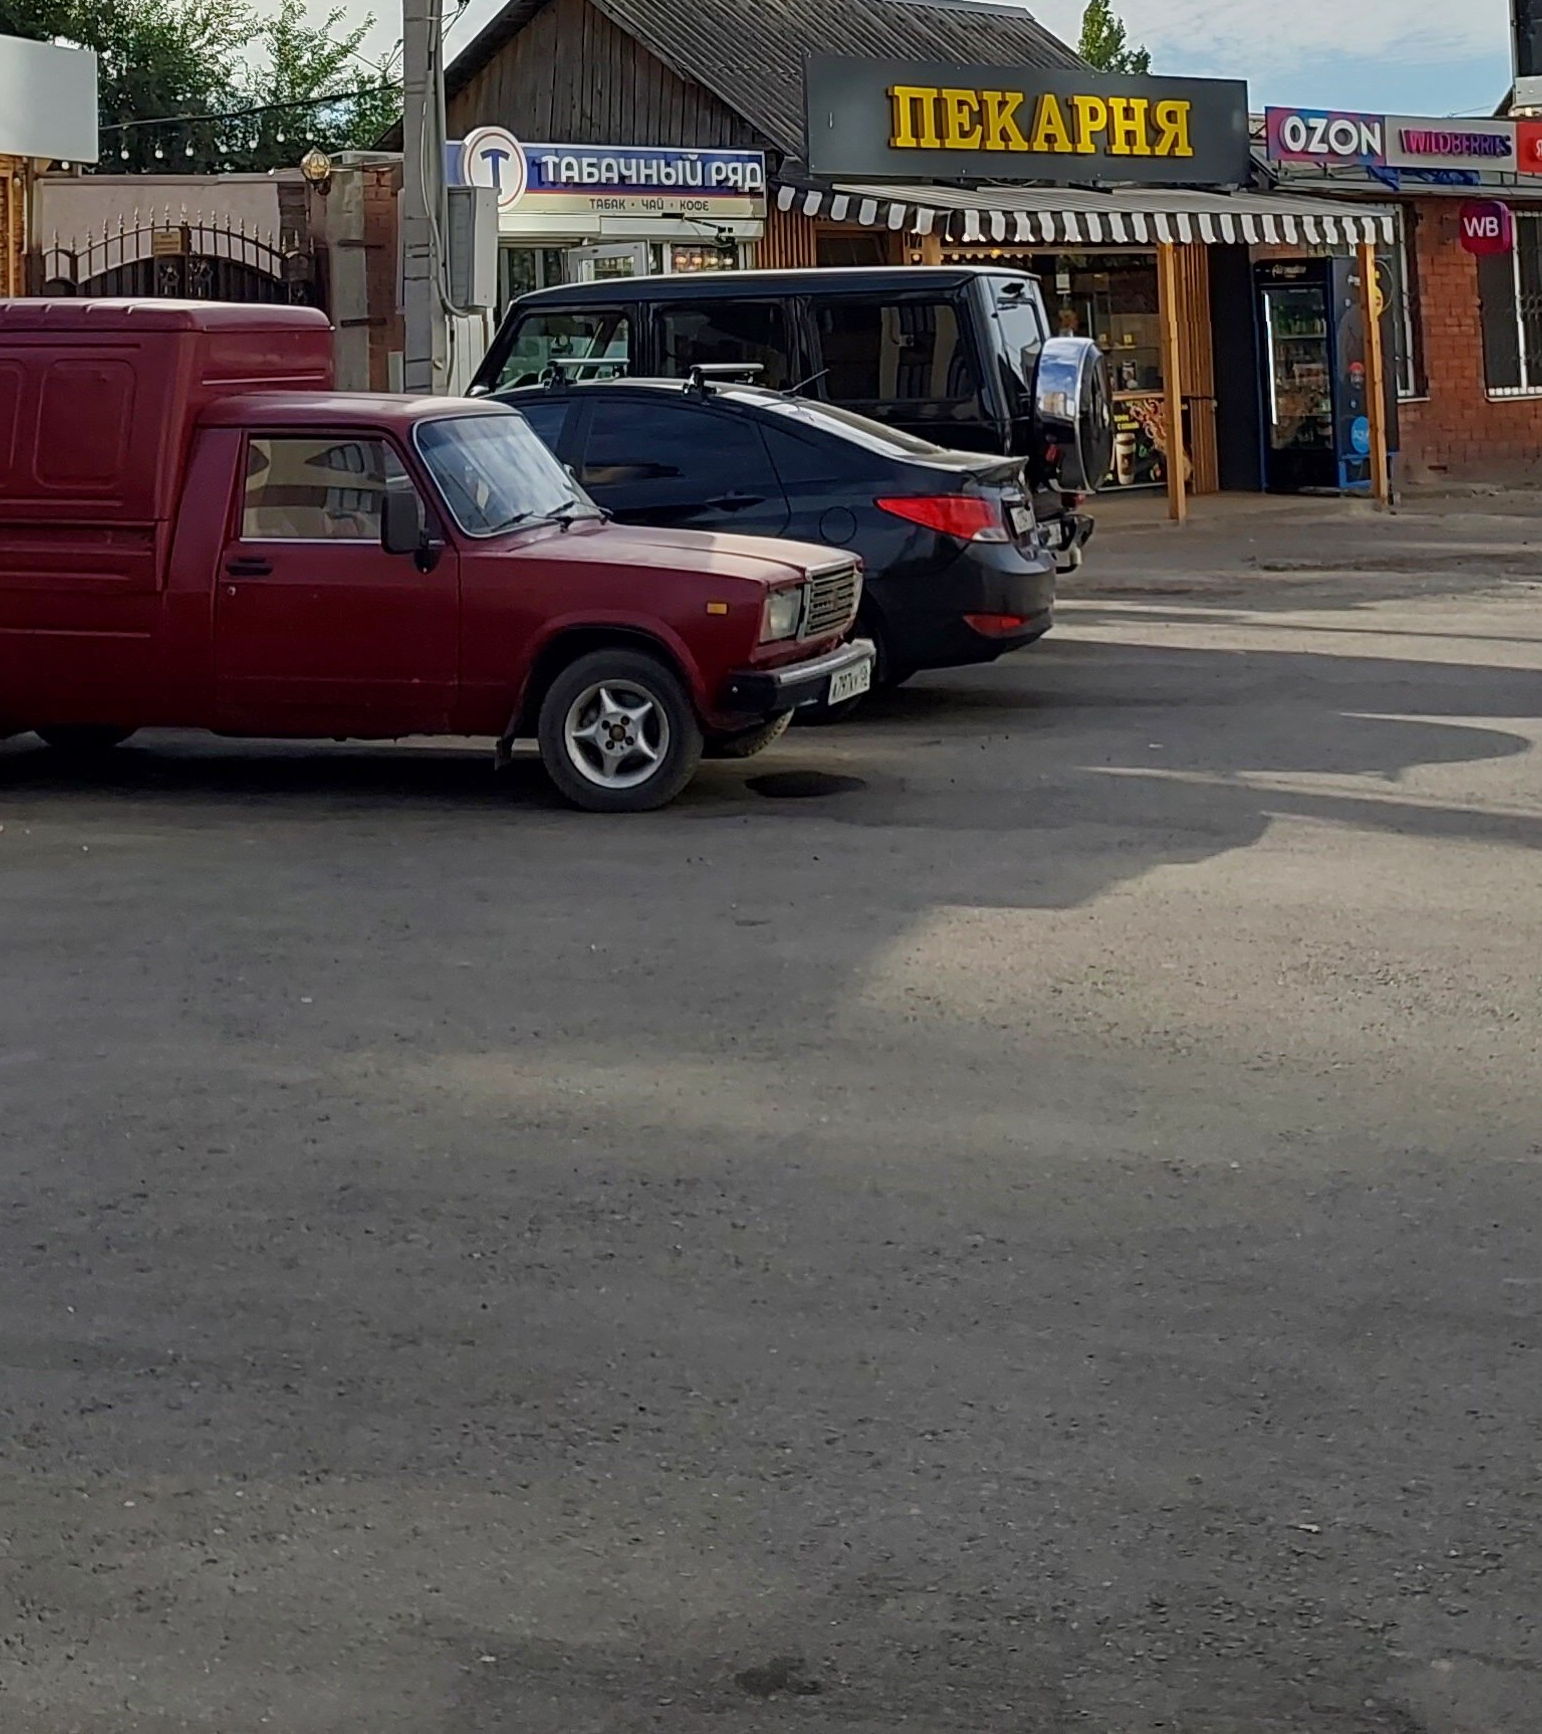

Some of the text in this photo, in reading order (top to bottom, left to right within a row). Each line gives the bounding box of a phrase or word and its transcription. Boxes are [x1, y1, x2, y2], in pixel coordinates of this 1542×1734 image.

[888, 85, 1194, 157] ПЕКАРНЯ
[1281, 116, 1382, 156] OZON
[1401, 128, 1512, 157] WILDBERRIES
[539, 154, 762, 192] ТАБАЧНЫЙ РЯД
[590, 197, 710, 211] ТАБАК ЧАЙ КОФЕ
[1463, 215, 1500, 238] WB
